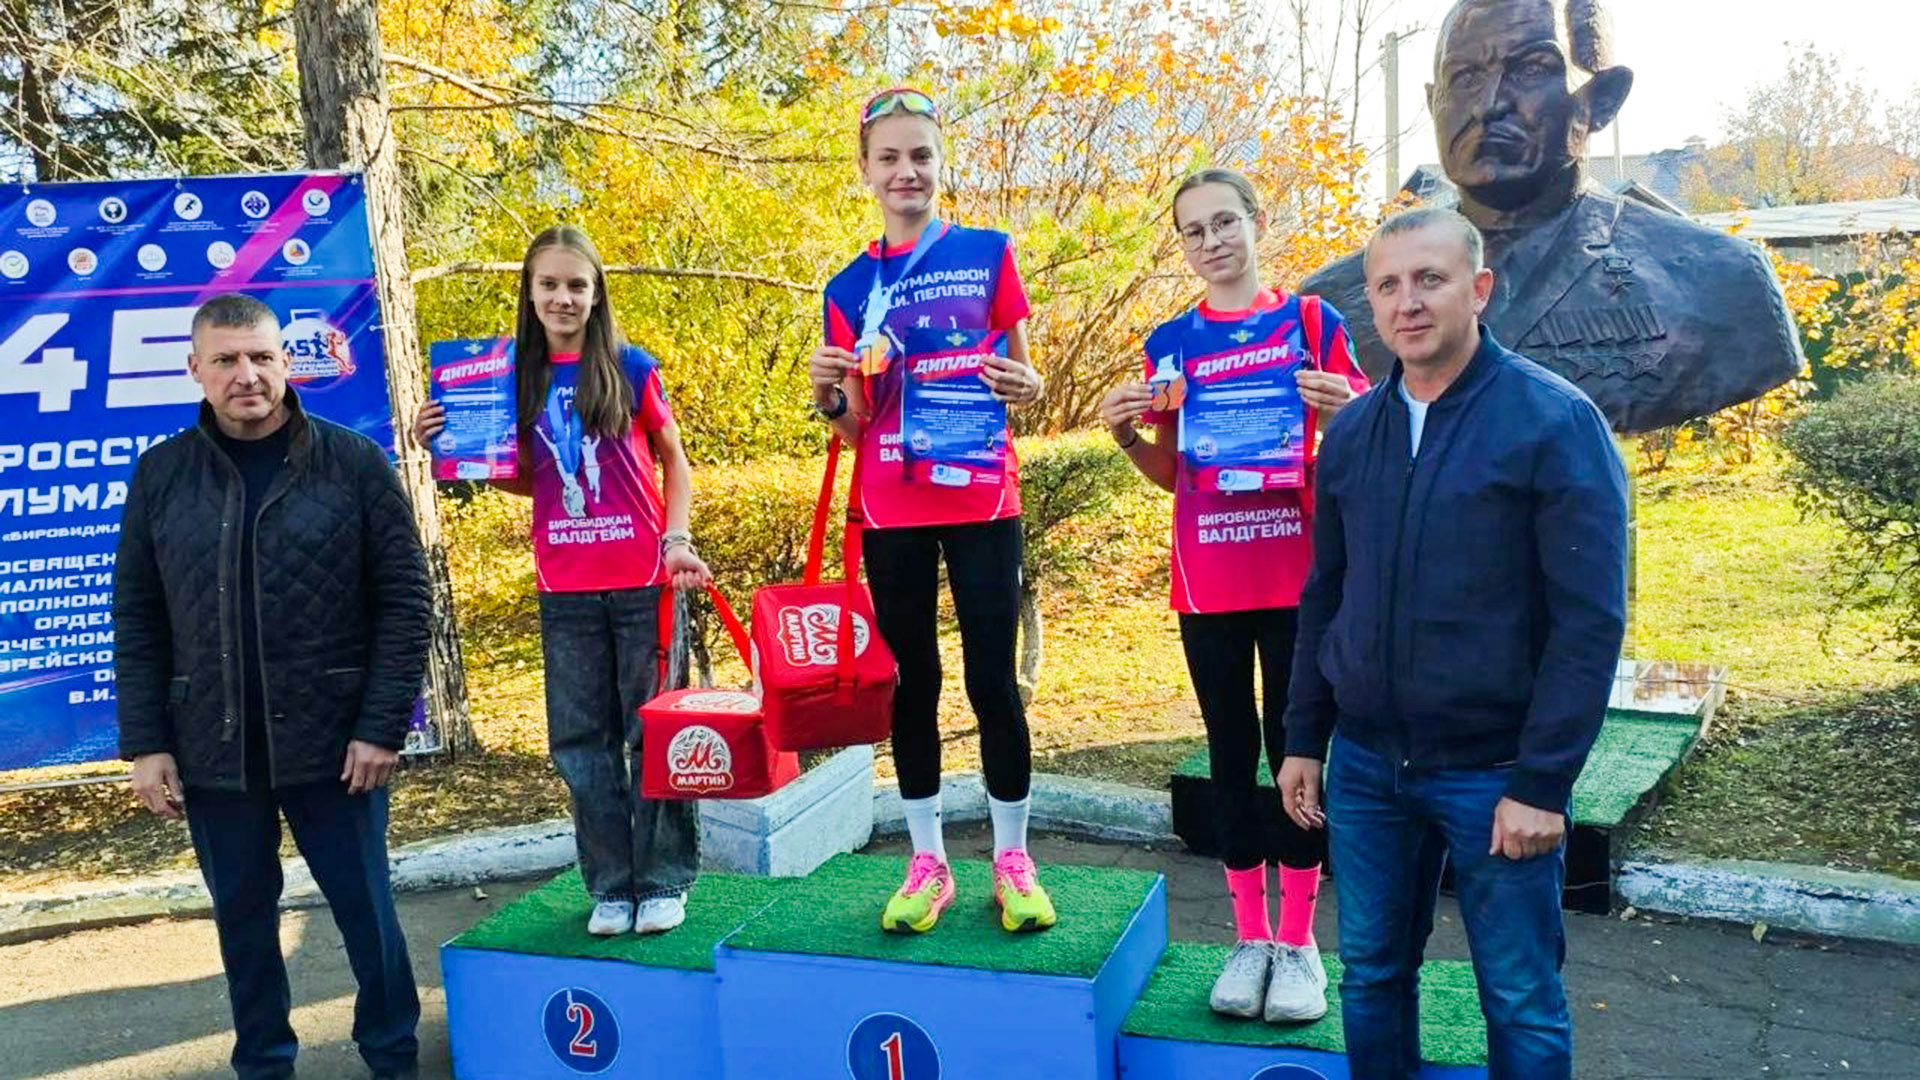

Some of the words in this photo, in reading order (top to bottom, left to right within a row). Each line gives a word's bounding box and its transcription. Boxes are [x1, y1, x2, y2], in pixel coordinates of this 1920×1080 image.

[878, 268, 990, 297] ОЛУМАРАФОН
[913, 284, 987, 303] ПЕЛЛЕРА
[0, 306, 206, 413] 45
[439, 357, 507, 381] ДИПЛОМ
[913, 353, 996, 374] ДИПЛО
[1194, 344, 1289, 377] ДИПЛОМ
[0, 428, 186, 473] РОССИ
[547, 514, 632, 531] БИРОБИДЖАН
[1198, 507, 1301, 527] БИРОБИДЖАН
[548, 526, 635, 545] ВАЛДГЕЙМ
[1198, 520, 1303, 544] ВАЛДГЕЙМ
[0, 592, 113, 615] ПОЛНОМ
[785, 612, 806, 660] МАРТИН
[69, 688, 116, 704] В.И.
[676, 774, 727, 786] МАРТИН
[566, 1001, 597, 1057] 2
[880, 1032, 905, 1080] 1
